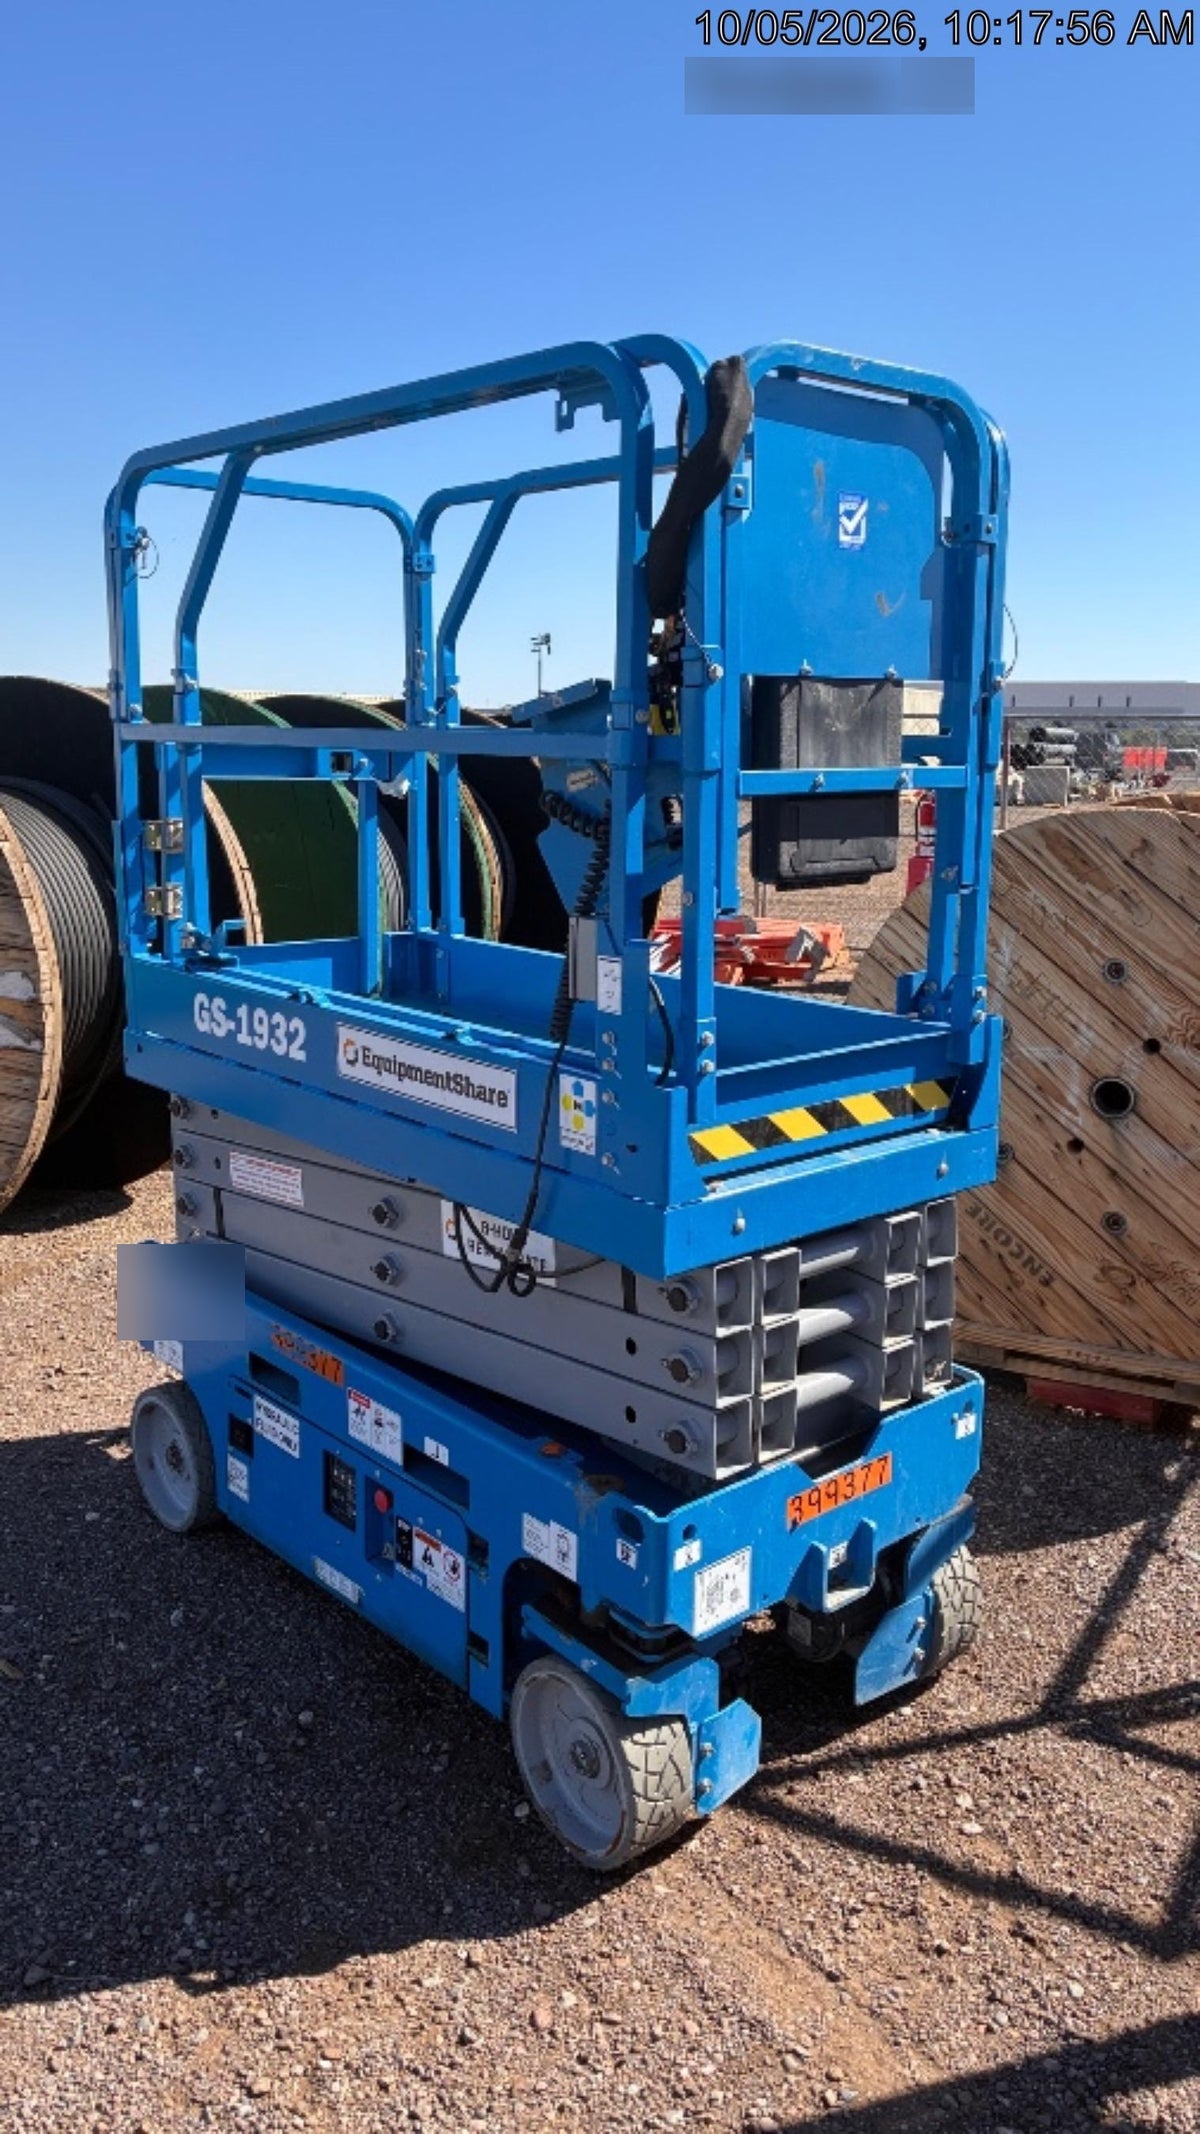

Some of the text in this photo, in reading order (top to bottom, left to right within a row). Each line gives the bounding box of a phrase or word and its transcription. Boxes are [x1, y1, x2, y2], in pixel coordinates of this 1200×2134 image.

[193, 992, 306, 1063] GS-1932
[360, 1045, 509, 1108] EquipmentShare
[965, 1206, 1054, 1287] ENCORE
[789, 1455, 889, 1527] 399377
